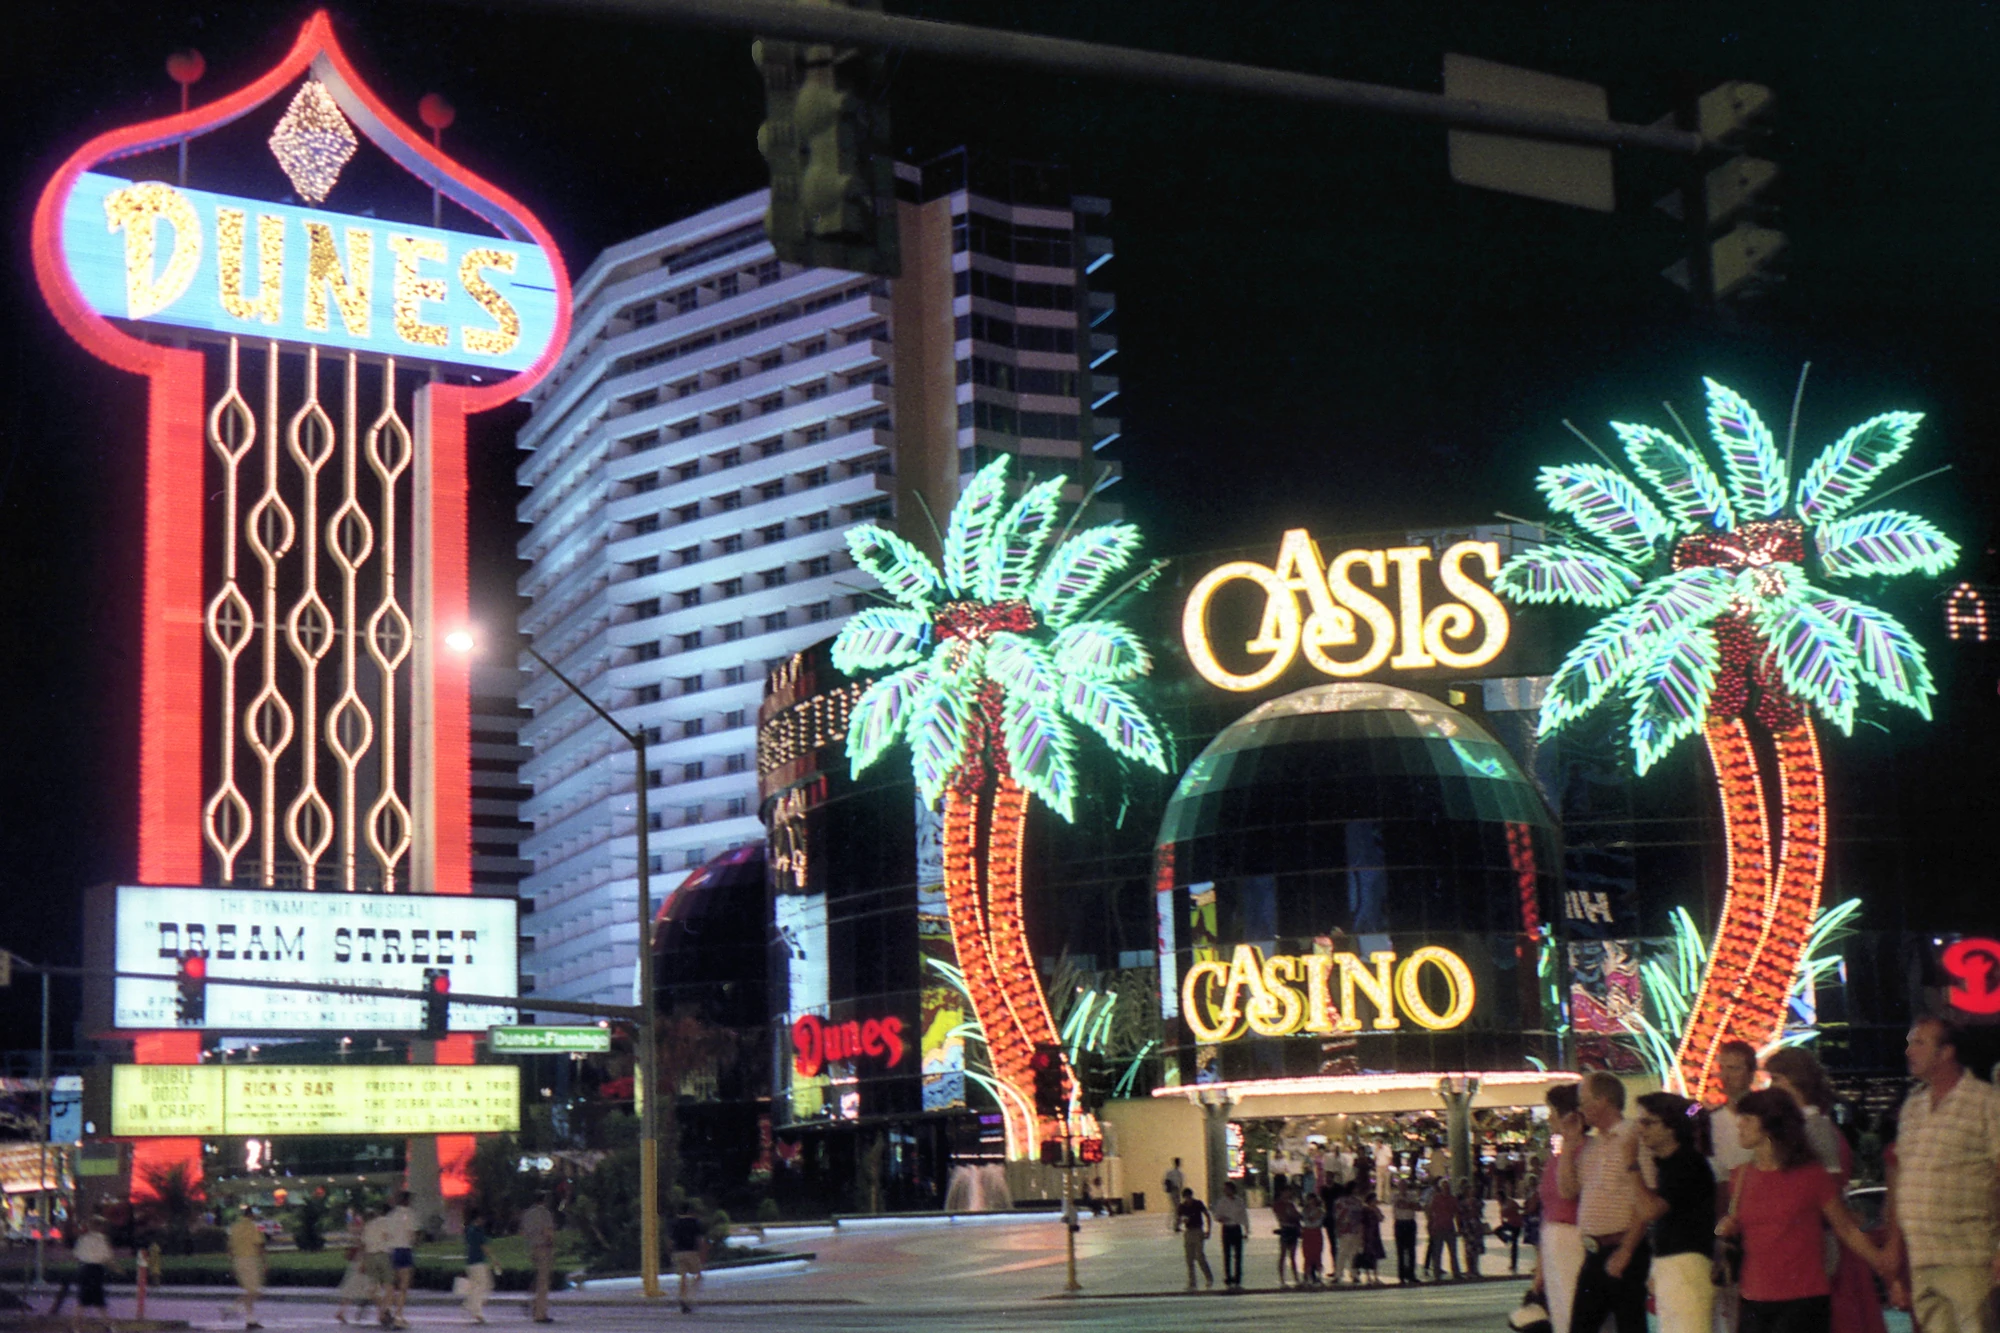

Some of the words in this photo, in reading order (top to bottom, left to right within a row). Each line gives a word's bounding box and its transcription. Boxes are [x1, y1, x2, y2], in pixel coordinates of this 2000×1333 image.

[103, 180, 521, 355] DUNES
[1182, 528, 1510, 691] OASIS
[792, 1014, 903, 1077] Dunes
[1183, 944, 1476, 1042] CASINO
